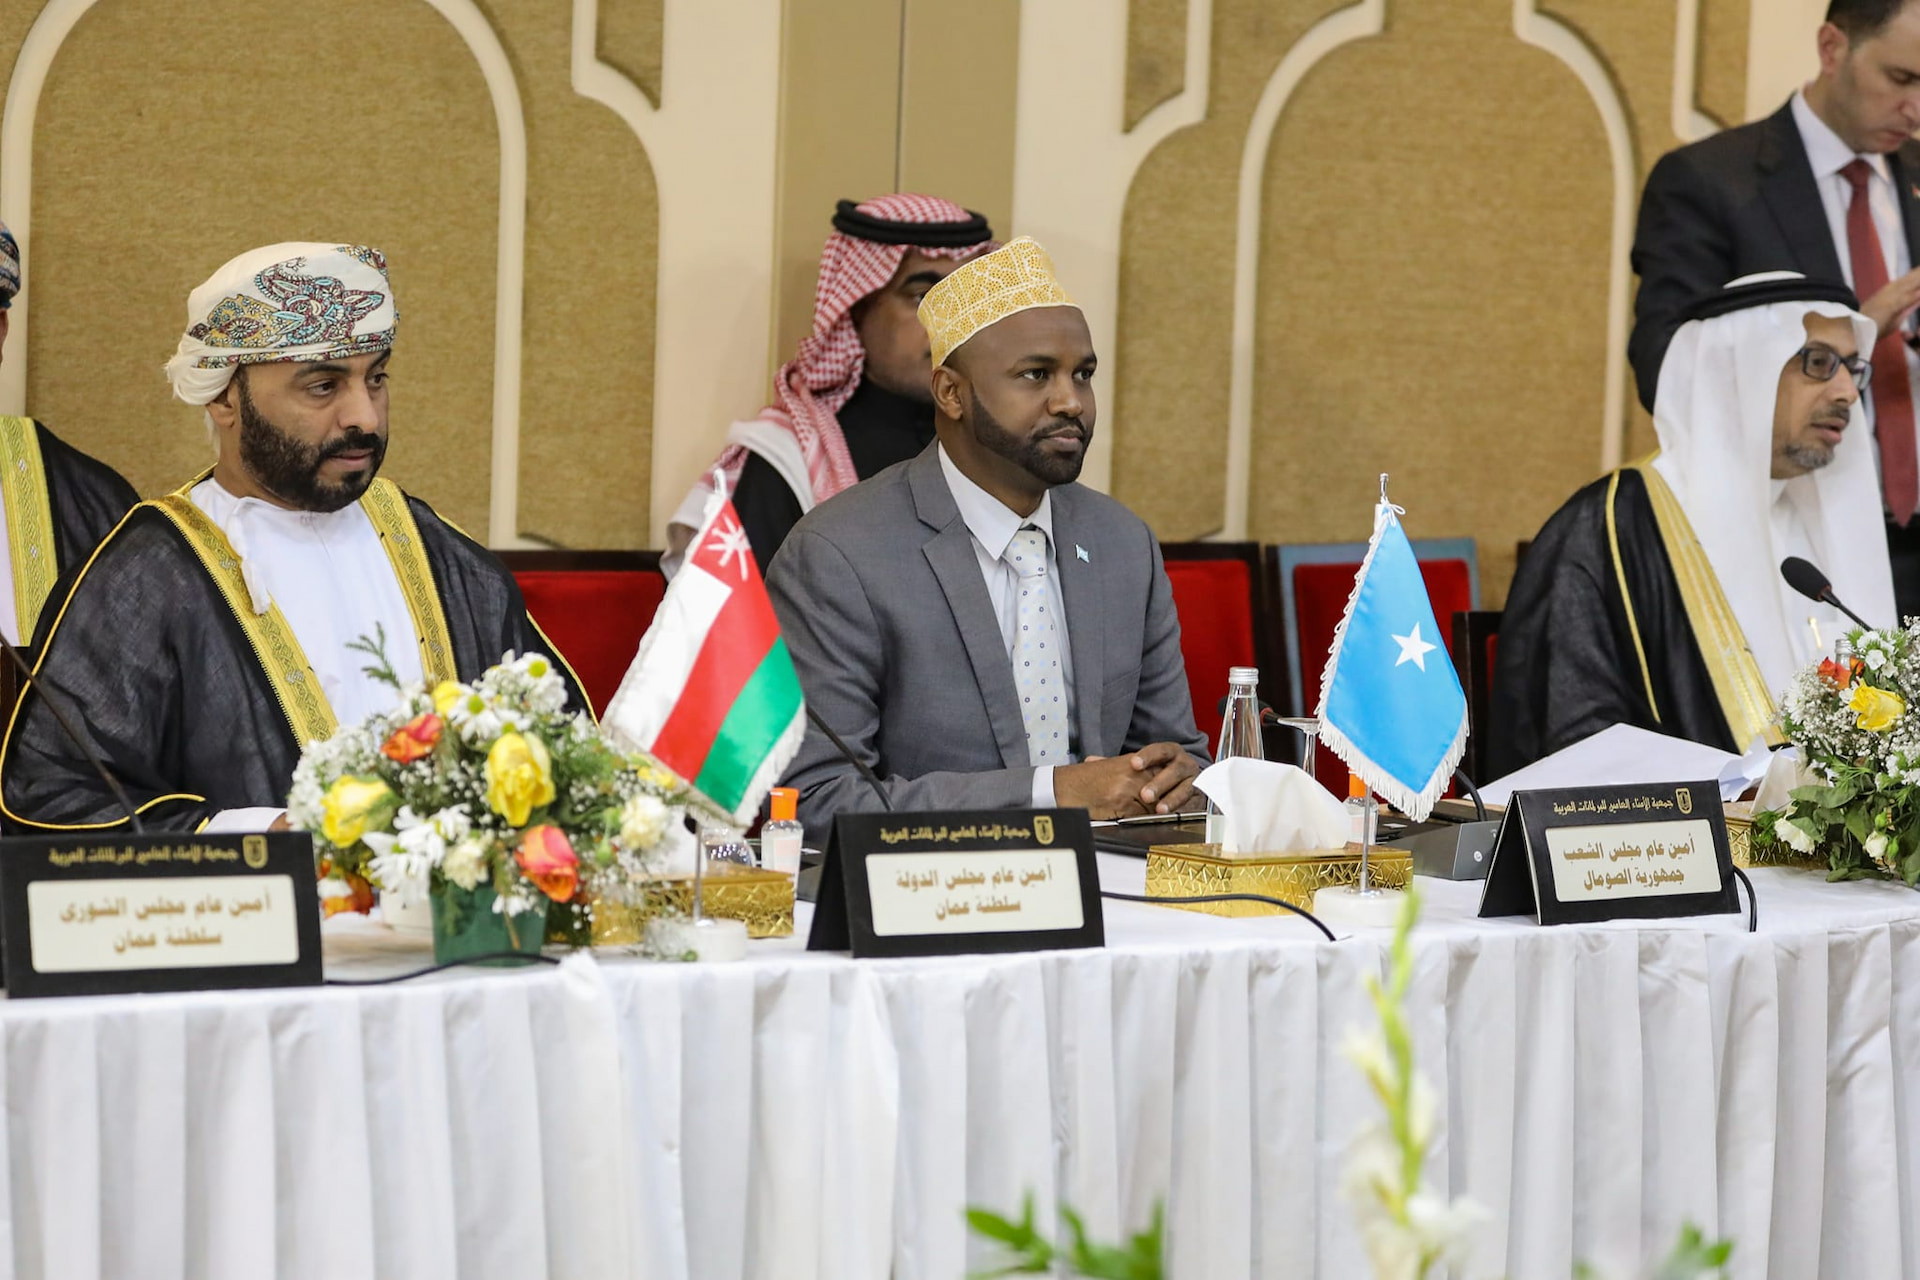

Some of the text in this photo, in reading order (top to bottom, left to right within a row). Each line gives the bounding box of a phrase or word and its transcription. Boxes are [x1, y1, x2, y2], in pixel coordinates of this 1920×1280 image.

[1553, 801, 1577, 816] العربية
[1651, 796, 1674, 810] جمعية
[1563, 832, 1695, 865] أمين عام مجلس الشعب
[896, 857, 1052, 893] أمين عام مجلس الدولة
[1583, 866, 1685, 891] جمهورية الصومال
[135, 894, 186, 921] مجلس
[193, 893, 223, 919] عام
[228, 884, 271, 918] أمين
[936, 895, 1021, 921] سلطنة عمان
[113, 926, 223, 954] سلطنة عمان
